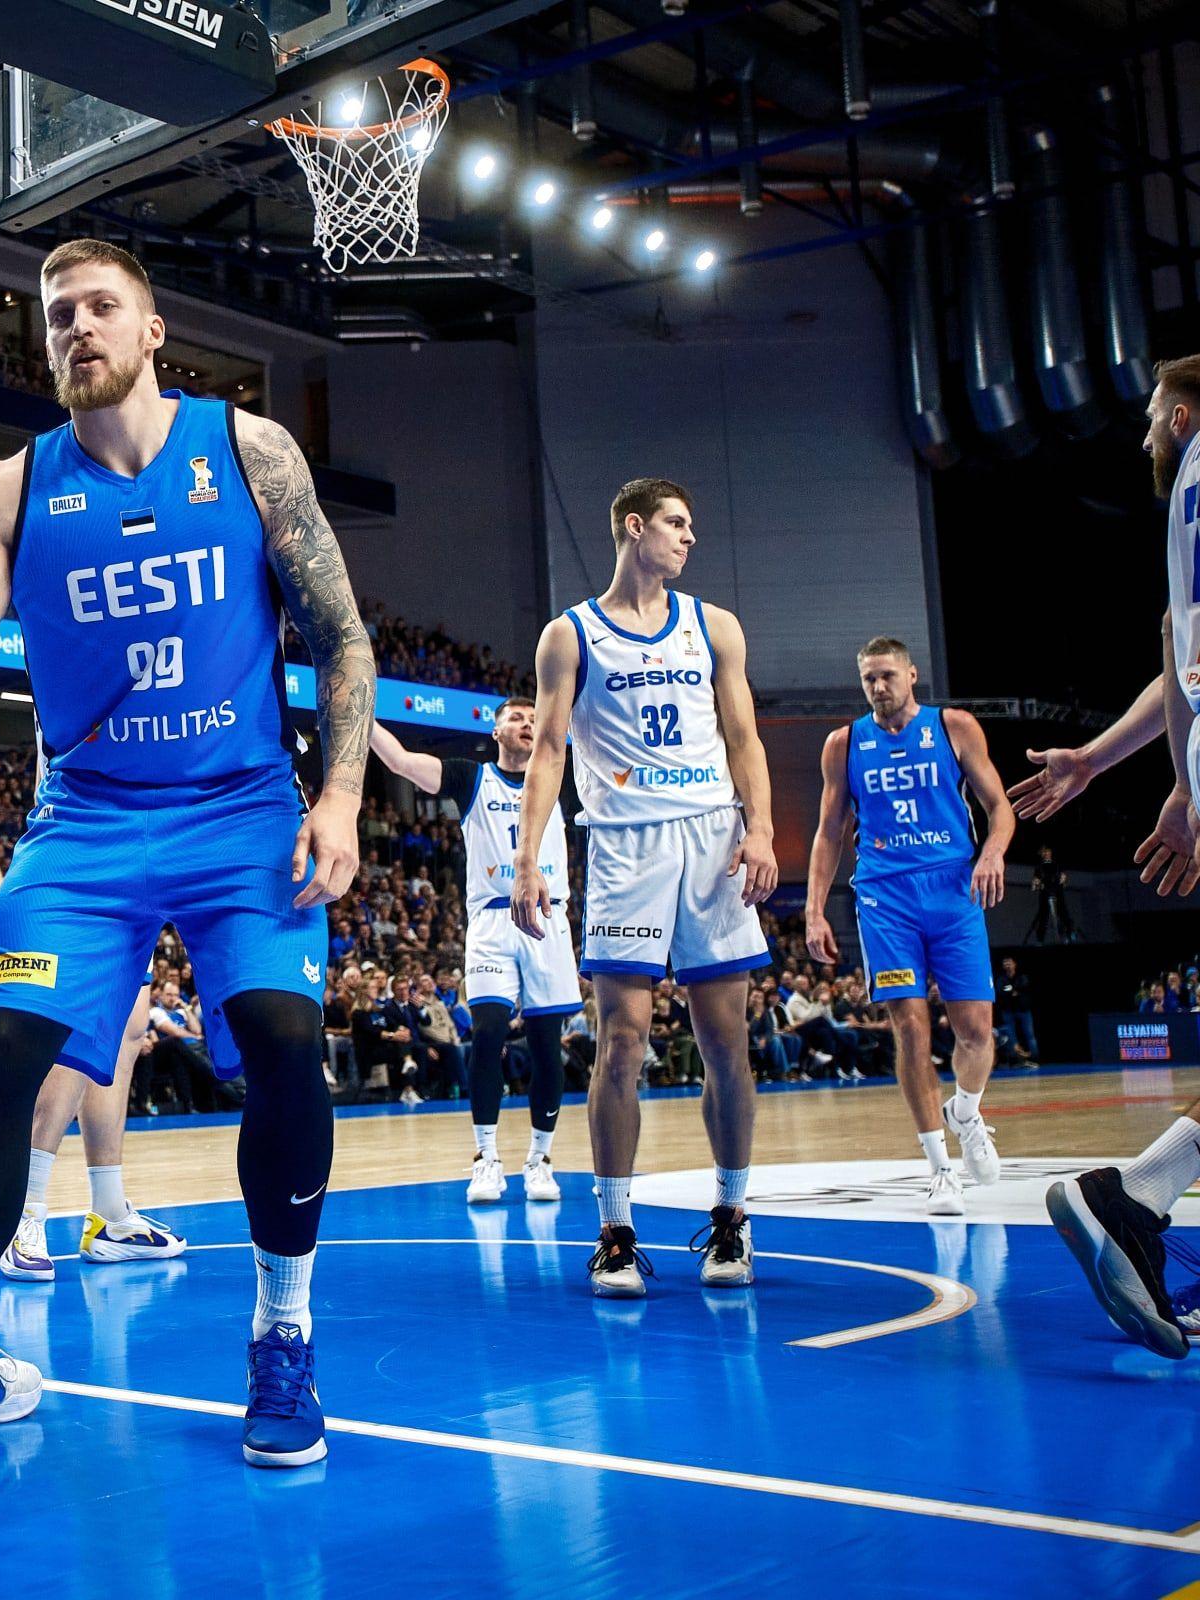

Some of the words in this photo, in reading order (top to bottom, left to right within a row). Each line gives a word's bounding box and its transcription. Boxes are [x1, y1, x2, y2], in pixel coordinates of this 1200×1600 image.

[52, 496, 83, 512] BALLZY
[66, 546, 225, 623] EESTI
[126, 636, 184, 691] 99
[605, 669, 702, 692] ČESKO
[414, 694, 445, 716] Delfi
[108, 700, 237, 742] UTILITAS
[641, 703, 683, 748] 32
[864, 762, 938, 794] EESTI
[487, 801, 521, 812] ČES
[892, 799, 919, 824] 21
[889, 831, 951, 847] UTILITAS
[588, 925, 662, 938] JAECOO
